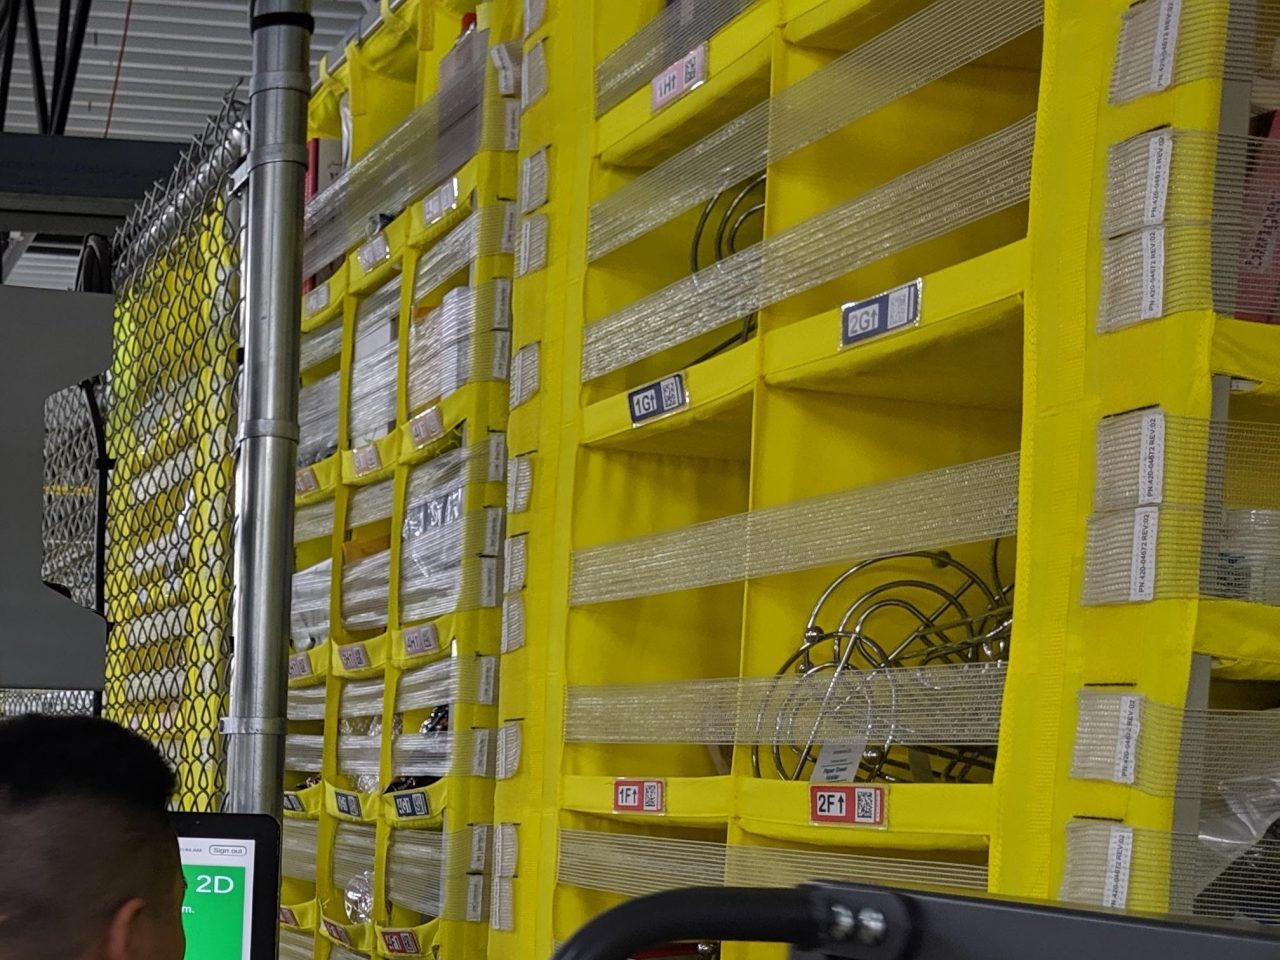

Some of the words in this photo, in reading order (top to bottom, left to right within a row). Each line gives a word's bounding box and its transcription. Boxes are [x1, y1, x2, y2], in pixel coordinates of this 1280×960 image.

[849, 312, 870, 333] 2G
[634, 394, 650, 412] 1G
[1147, 447, 1155, 497] PN:420-04672
[1141, 514, 1149, 541] REV:02
[1138, 542, 1147, 592] PN:420-04672
[1126, 700, 1135, 726] REV:02
[619, 787, 632, 804] 1F
[818, 794, 836, 813] 2F
[195, 874, 234, 894] 2D
